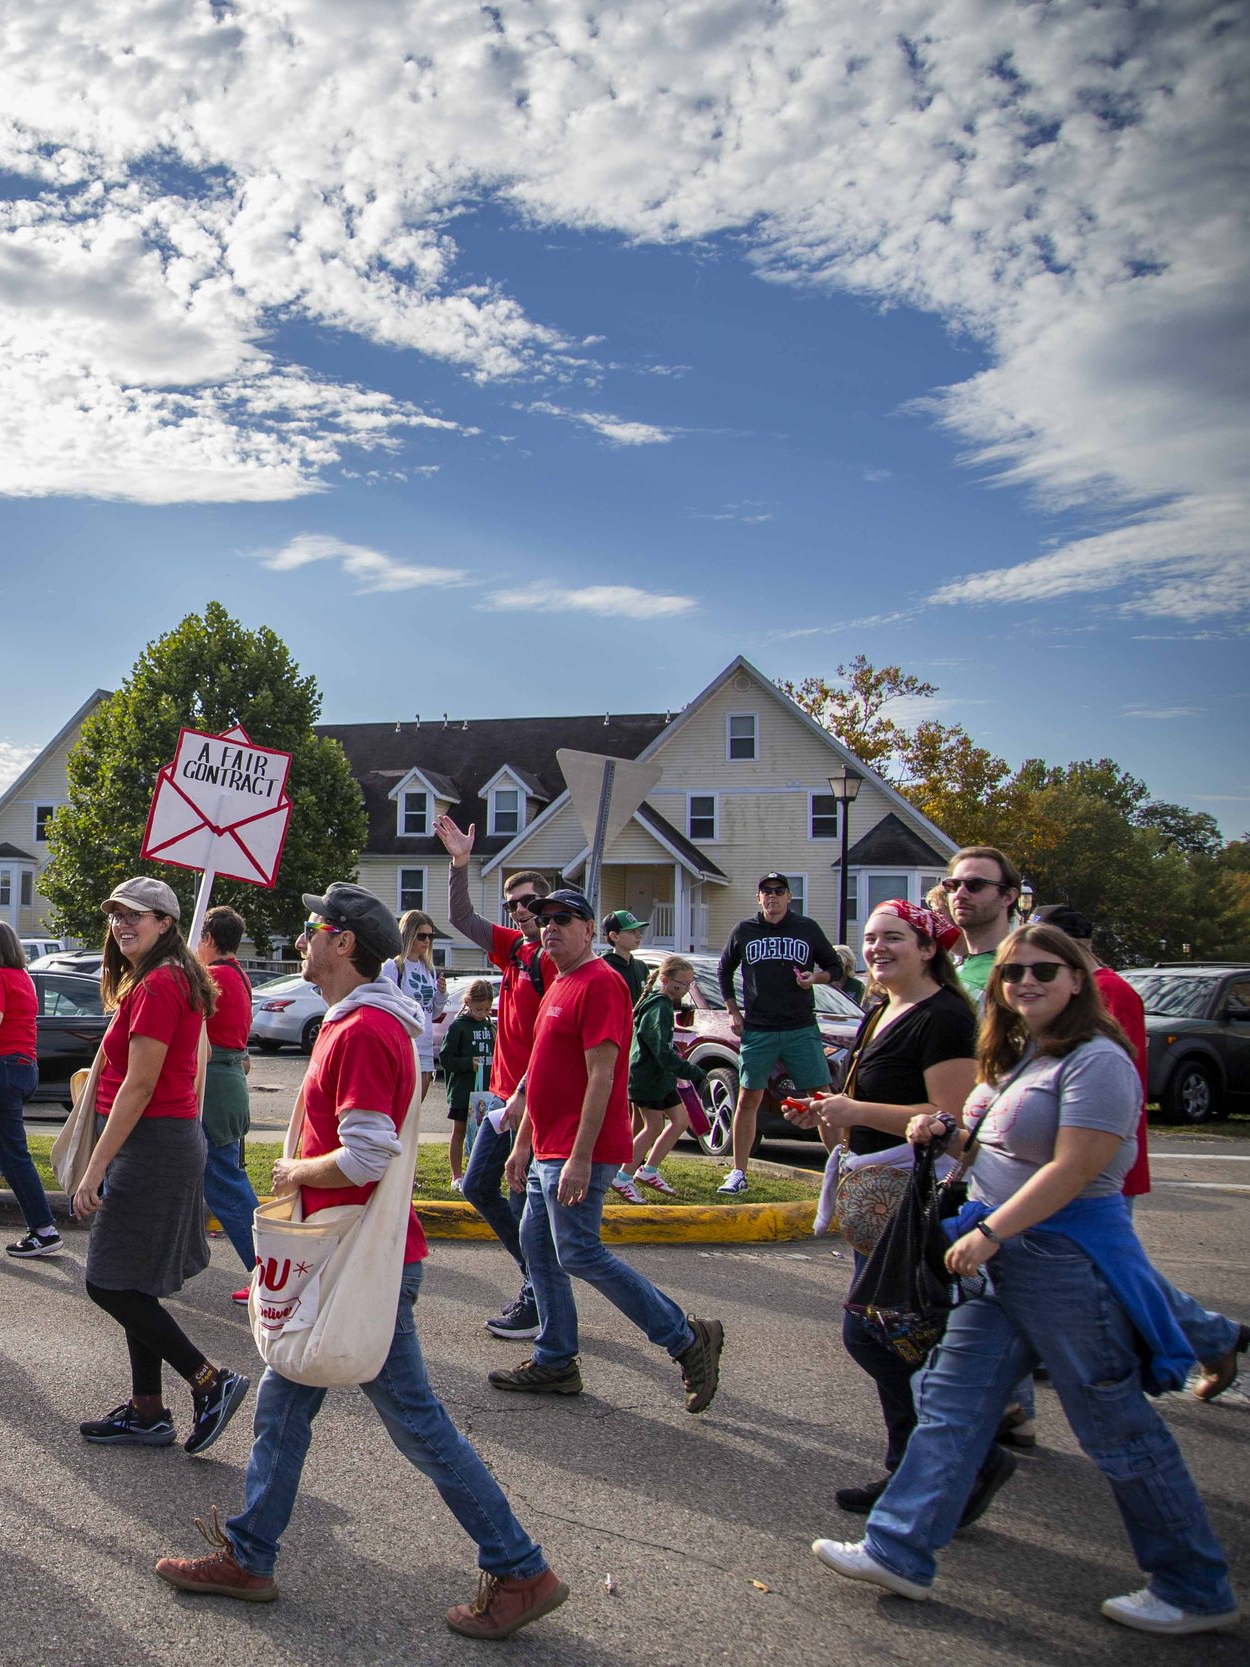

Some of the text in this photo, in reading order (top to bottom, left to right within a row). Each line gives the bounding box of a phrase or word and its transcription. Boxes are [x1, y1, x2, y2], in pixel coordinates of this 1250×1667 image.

[197, 742, 269, 777] A FAIR
[182, 760, 280, 798] CONTRACT
[745, 936, 810, 966] OHIO
[195, 1364, 209, 1380] Cool
